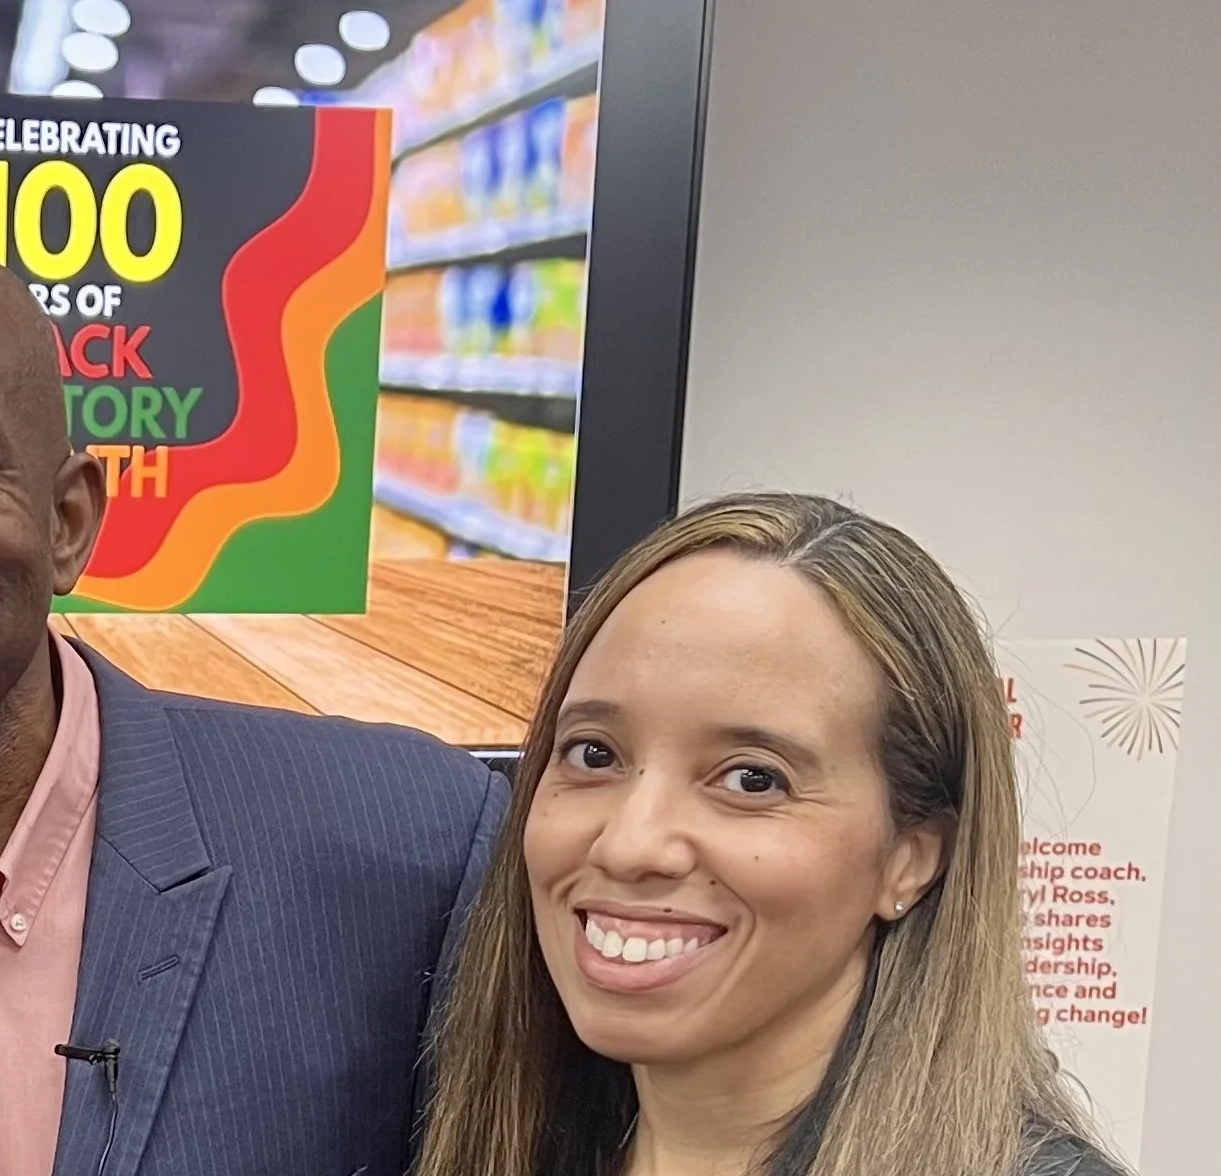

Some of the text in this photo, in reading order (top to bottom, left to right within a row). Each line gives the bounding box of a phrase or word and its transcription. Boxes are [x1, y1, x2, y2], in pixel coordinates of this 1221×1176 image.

[76, 284, 122, 318] OF
[64, 384, 204, 440] TORY
[1020, 837, 1102, 856] elcome
[1034, 908, 1112, 928] shares
[1021, 931, 1104, 956] nsights
[1074, 981, 1117, 1000] and
[1055, 1003, 1147, 1029] change!
